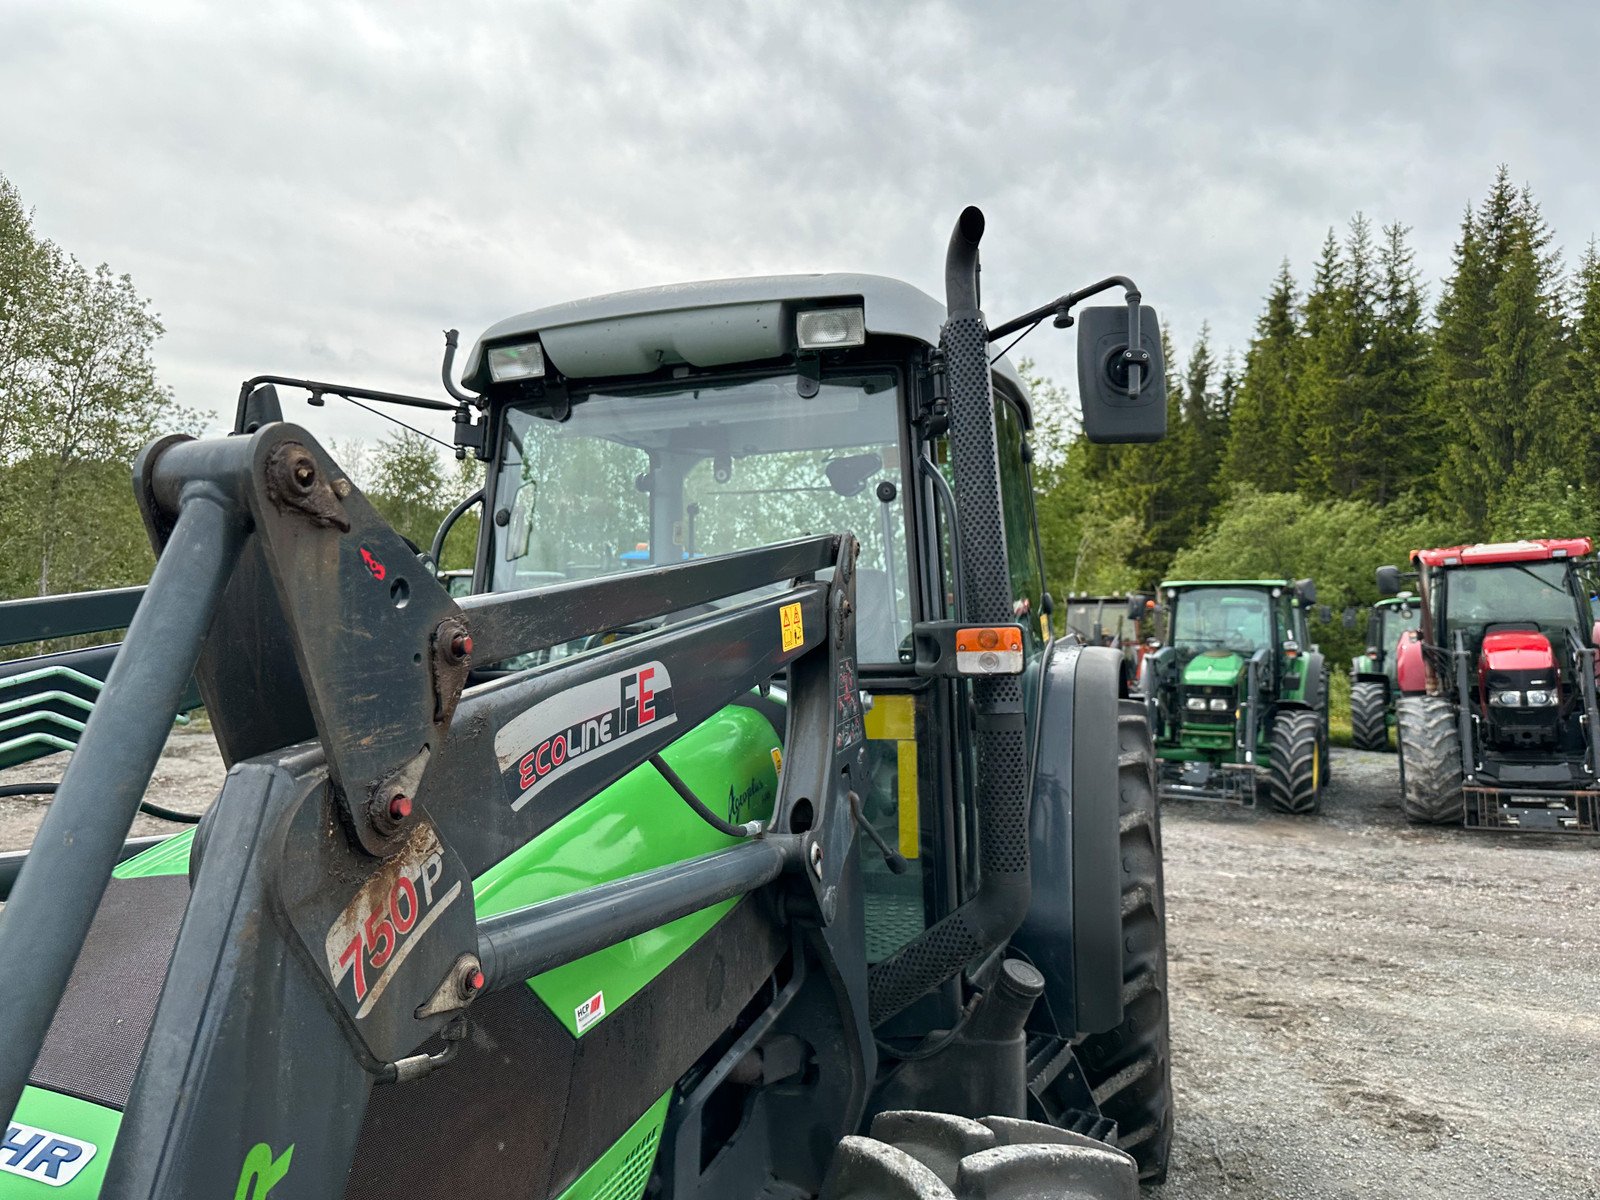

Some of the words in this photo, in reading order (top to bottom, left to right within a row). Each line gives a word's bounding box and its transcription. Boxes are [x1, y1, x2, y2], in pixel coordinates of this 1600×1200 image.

[519, 712, 613, 790] ECOLINE
[618, 667, 656, 736] FE
[577, 1003, 590, 1018] HCP
